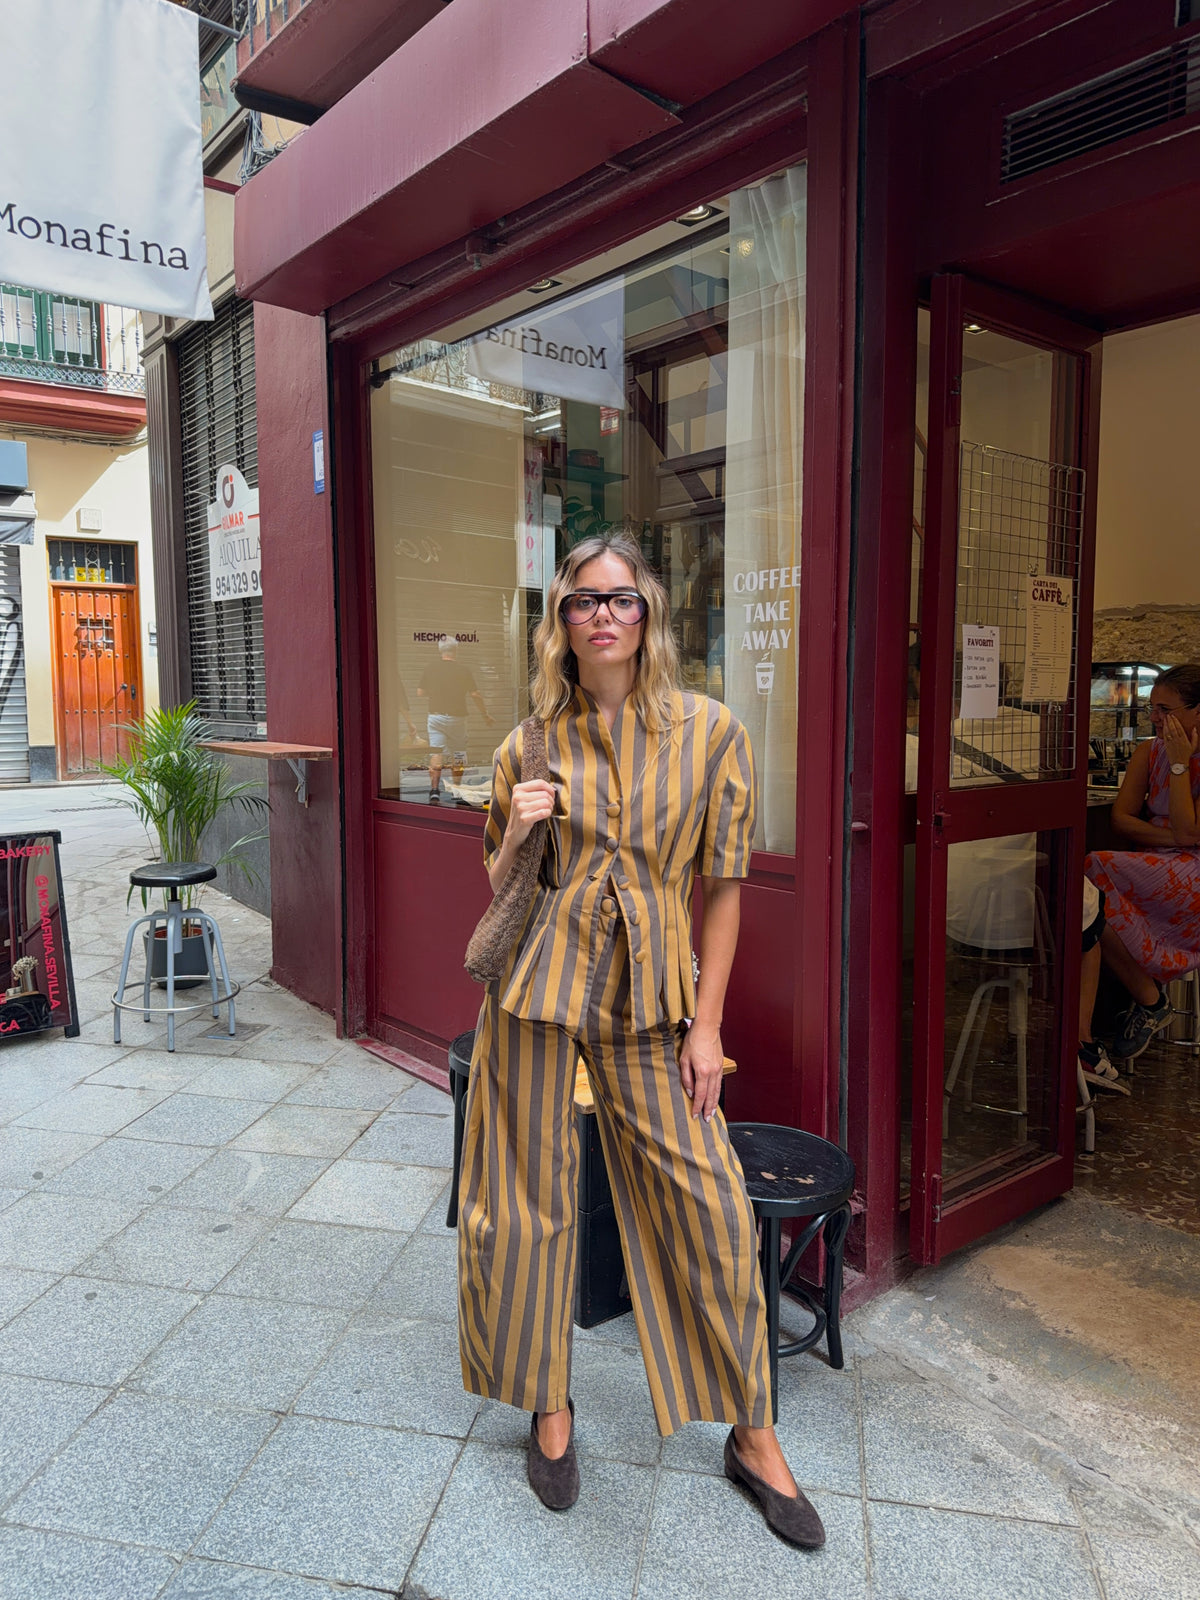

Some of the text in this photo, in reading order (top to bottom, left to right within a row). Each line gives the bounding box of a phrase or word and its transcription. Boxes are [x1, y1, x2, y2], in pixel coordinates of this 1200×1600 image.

[0, 202, 190, 270] Monafina
[733, 565, 801, 593] COFFEE
[1032, 579, 1048, 588] CARTA
[743, 600, 790, 624] TAKE
[413, 632, 447, 642] HECHO
[740, 628, 792, 651] AWAY
[967, 637, 994, 648] FAVORITI
[0, 845, 51, 859] BAKERY
